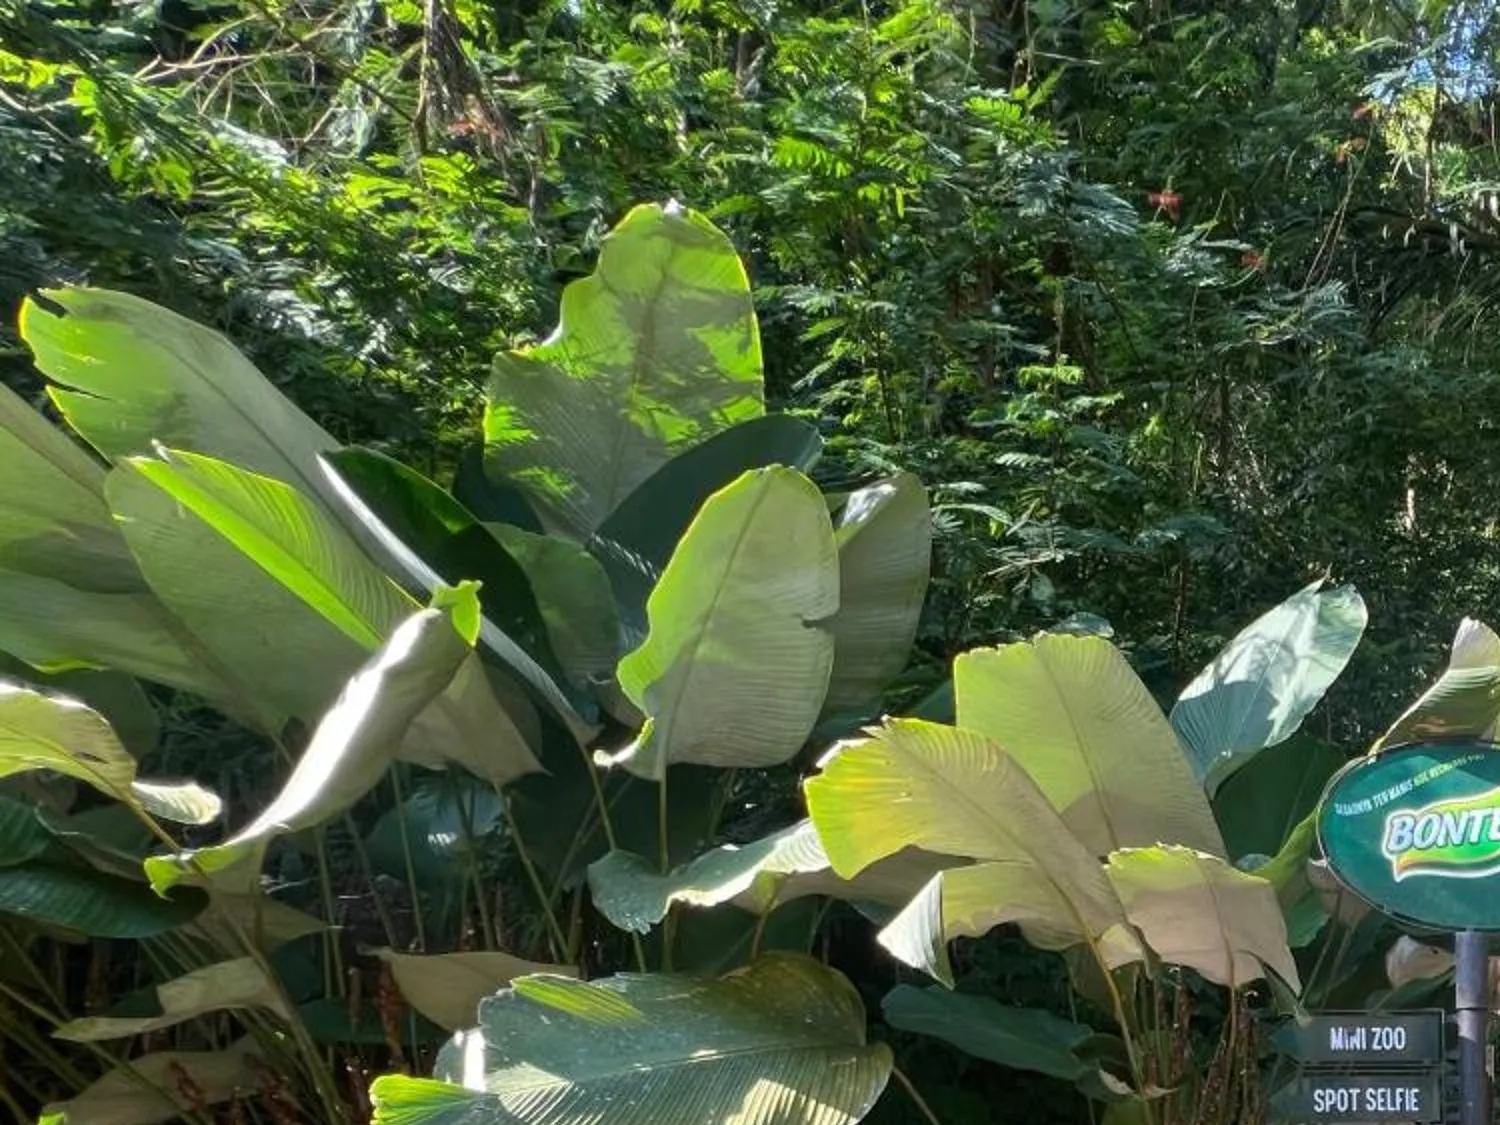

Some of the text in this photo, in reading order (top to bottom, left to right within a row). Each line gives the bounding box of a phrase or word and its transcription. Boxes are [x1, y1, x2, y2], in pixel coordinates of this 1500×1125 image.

[1330, 1027, 1406, 1050] MINI ZOO
[1313, 1088, 1420, 1112] SPOT SELFIE
